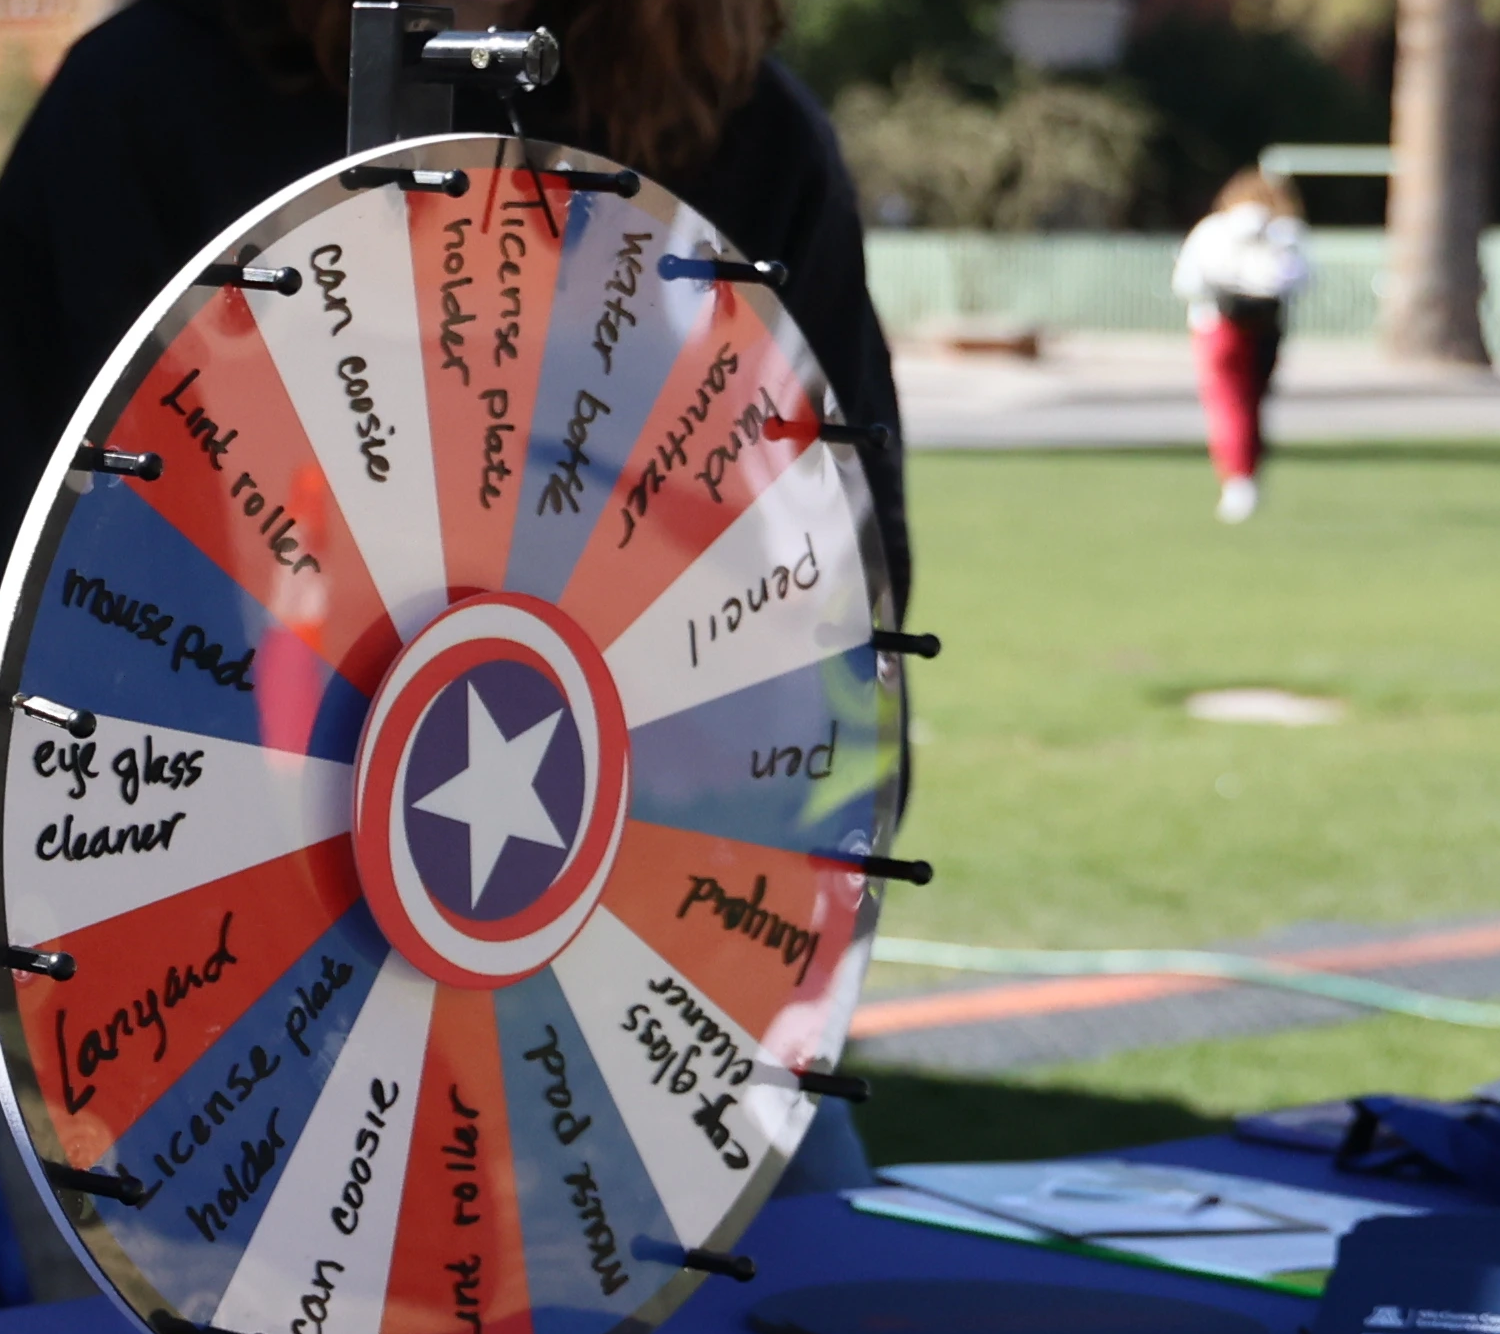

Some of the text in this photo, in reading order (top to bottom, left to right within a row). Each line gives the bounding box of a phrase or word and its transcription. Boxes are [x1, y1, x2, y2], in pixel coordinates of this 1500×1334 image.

[310, 244, 395, 483] can coosie
[440, 219, 476, 386] holder
[536, 233, 653, 517] water bottle
[160, 369, 320, 575] Lint roller
[478, 388, 515, 510] plate
[618, 342, 740, 549] sanitizer
[695, 386, 784, 503] hand
[689, 533, 821, 667] pencil
[33, 735, 204, 805] eye glass
[751, 720, 838, 781] pen
[36, 812, 187, 861] cleaner
[56, 911, 238, 1116] Lanyard
[286, 955, 354, 1057] plate
[648, 976, 753, 1086] cleaner
[523, 1024, 592, 1146] pad
[620, 1003, 750, 1170] eye glass
[186, 1106, 285, 1242] holder
[330, 1077, 400, 1236] coosie
[441, 1083, 480, 1227] roller
